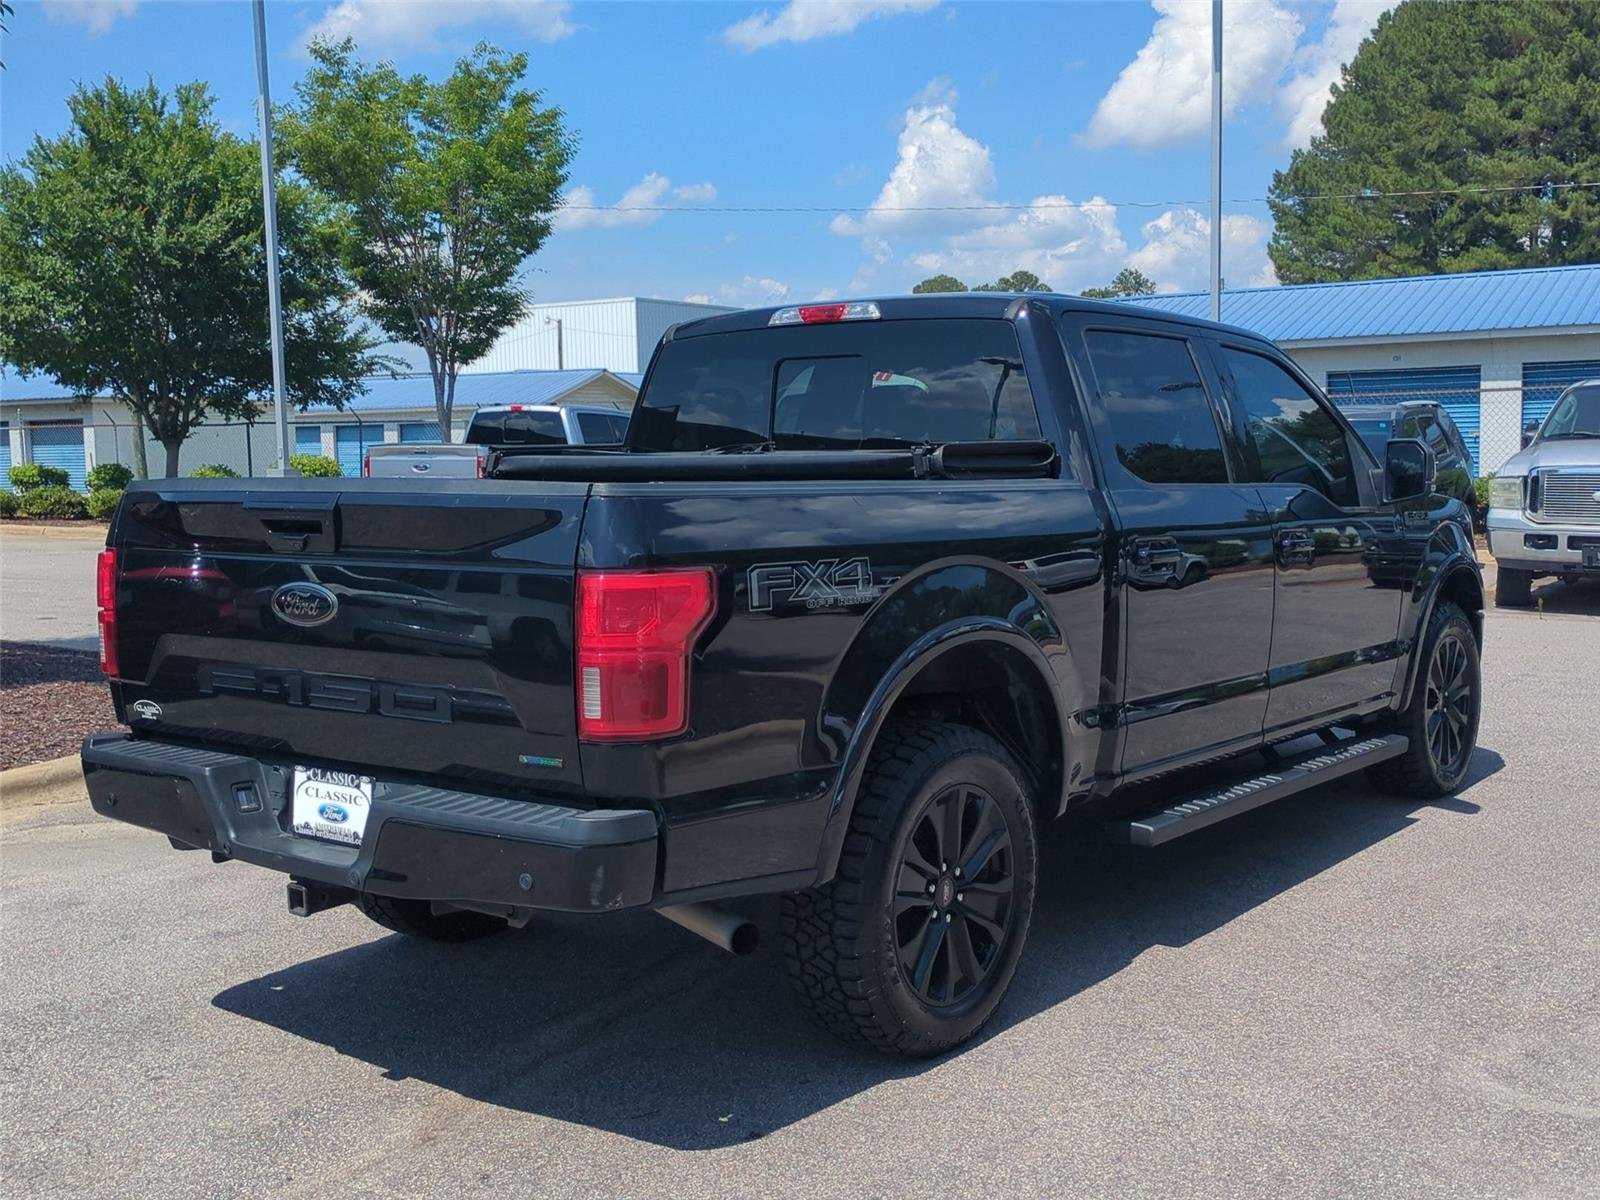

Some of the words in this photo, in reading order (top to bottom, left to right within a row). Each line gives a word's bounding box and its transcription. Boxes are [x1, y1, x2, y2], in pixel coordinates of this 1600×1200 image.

[747, 557, 873, 612] FX4
[284, 590, 319, 616] Ford
[806, 597, 834, 609] OFF
[310, 767, 357, 788] CLASSIC
[304, 785, 363, 807] CLASSIC
[322, 806, 345, 821] Ford
